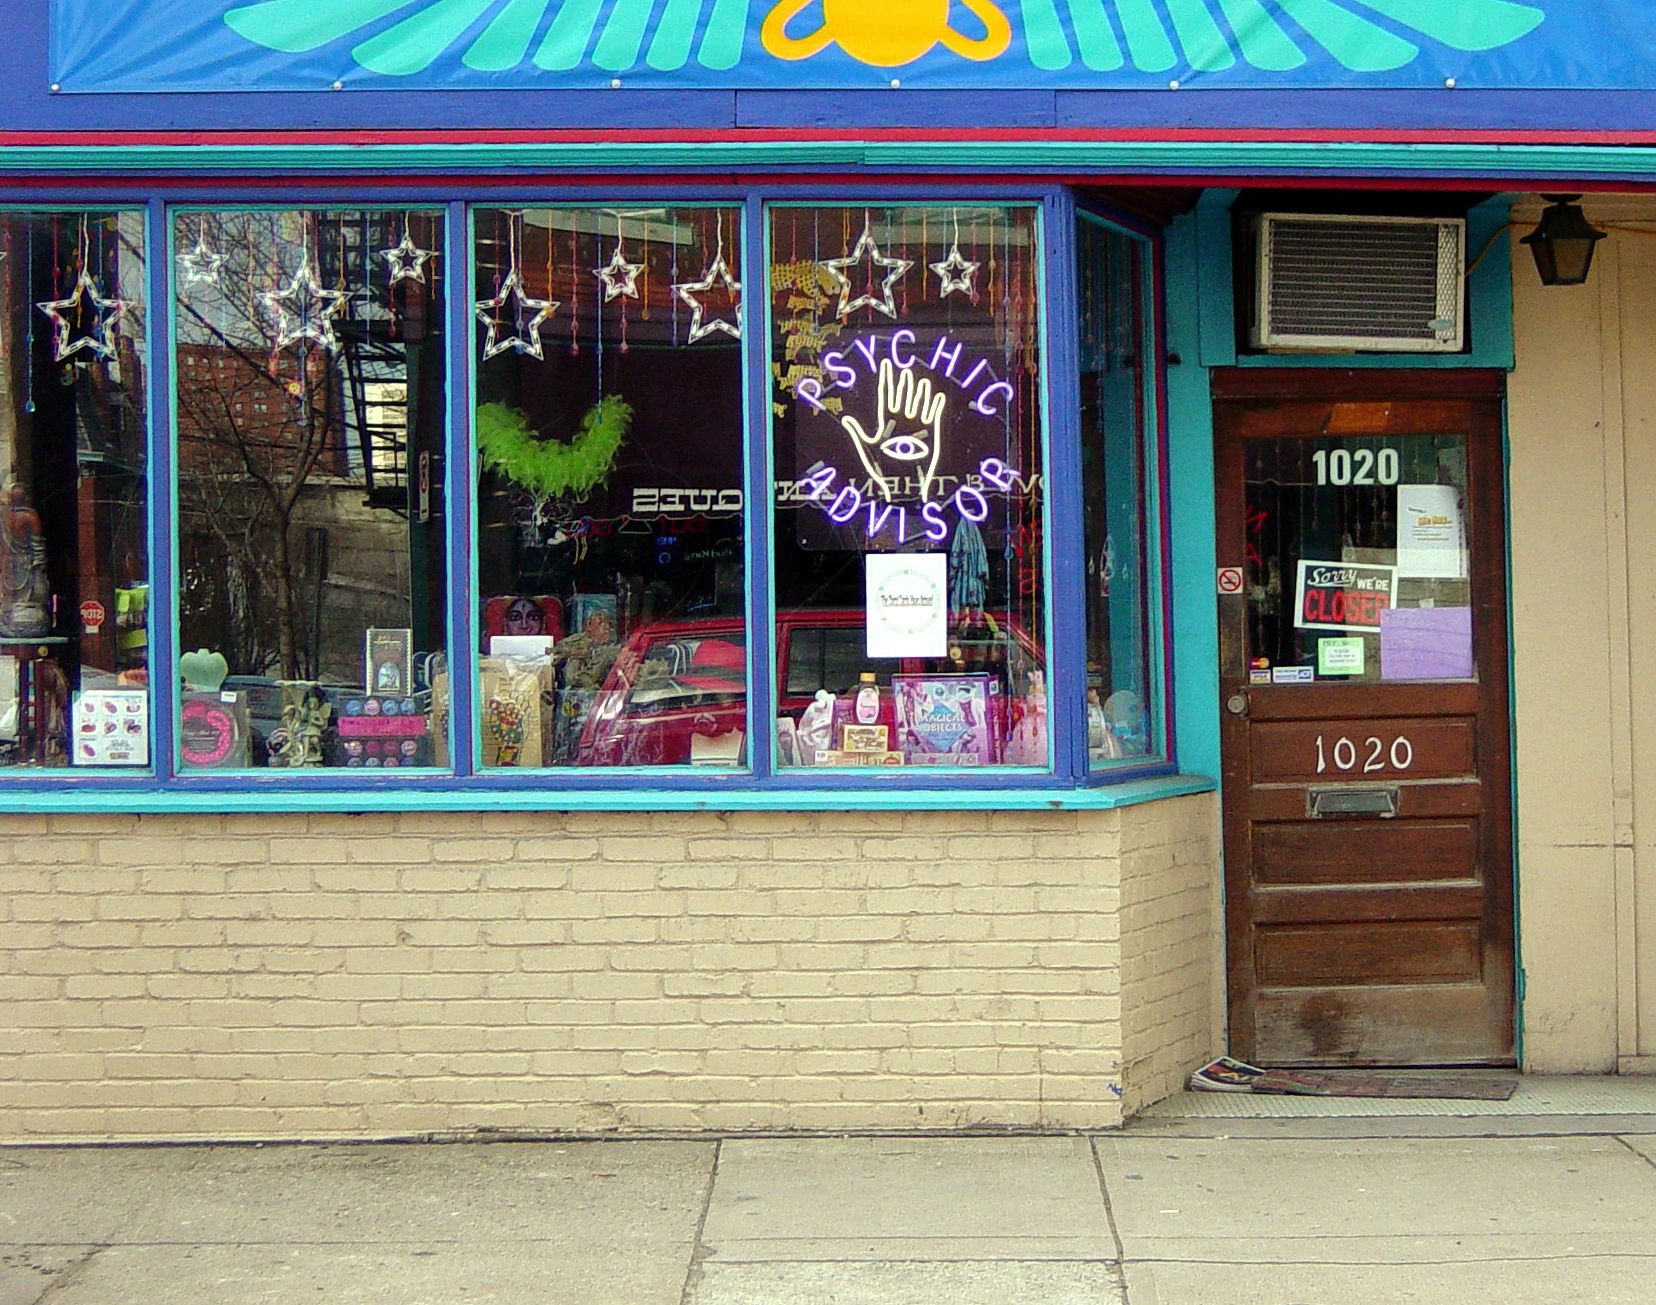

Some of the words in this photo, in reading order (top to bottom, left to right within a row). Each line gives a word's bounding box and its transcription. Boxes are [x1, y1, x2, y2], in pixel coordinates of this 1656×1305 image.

[798, 329, 1014, 415] PSYCHIC
[1312, 448, 1399, 486] 1020
[799, 457, 1021, 544] ADVISOR
[1307, 567, 1357, 588] Sorry
[1356, 576, 1389, 591] WE'RE
[1304, 588, 1389, 625] CLOSED
[1315, 735, 1413, 773] 1020
